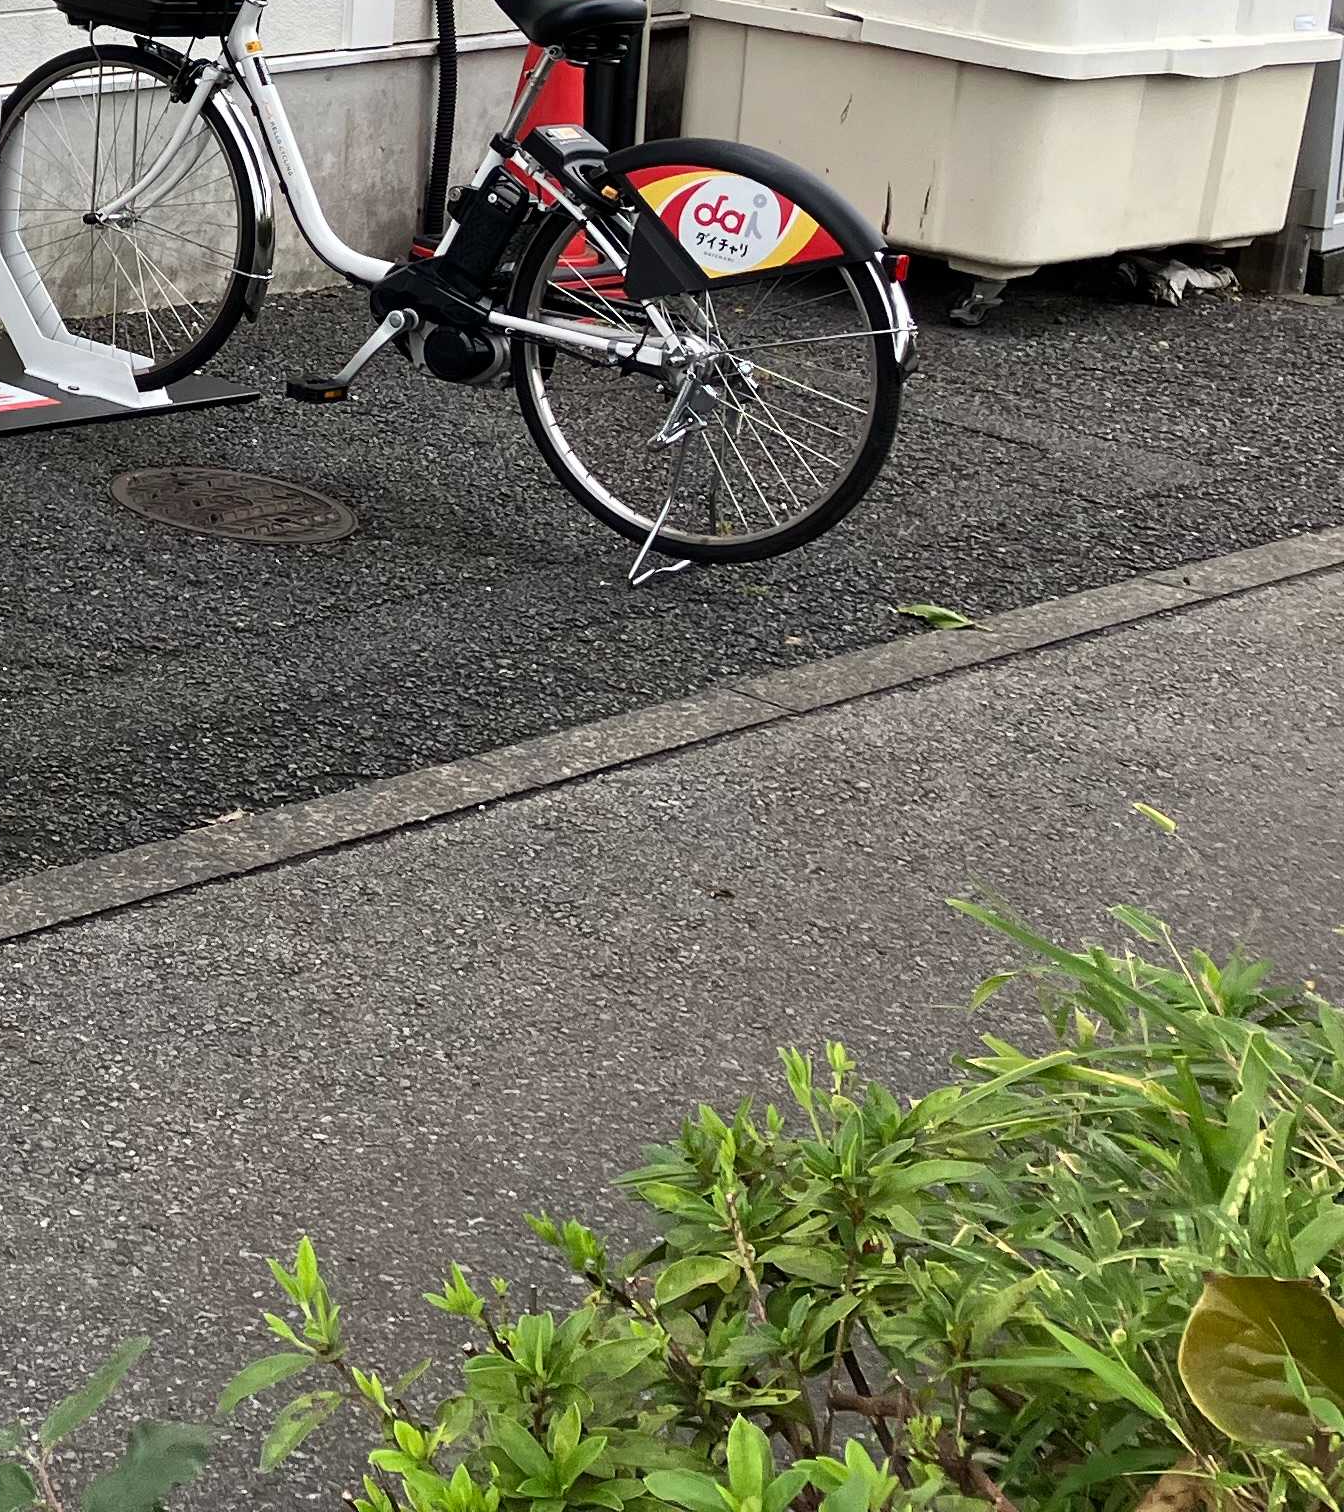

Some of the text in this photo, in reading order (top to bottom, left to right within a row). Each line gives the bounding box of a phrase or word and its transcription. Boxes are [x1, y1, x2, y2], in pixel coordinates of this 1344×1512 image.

[693, 193, 768, 239] dai
[695, 232, 749, 258] ダイチャリ
